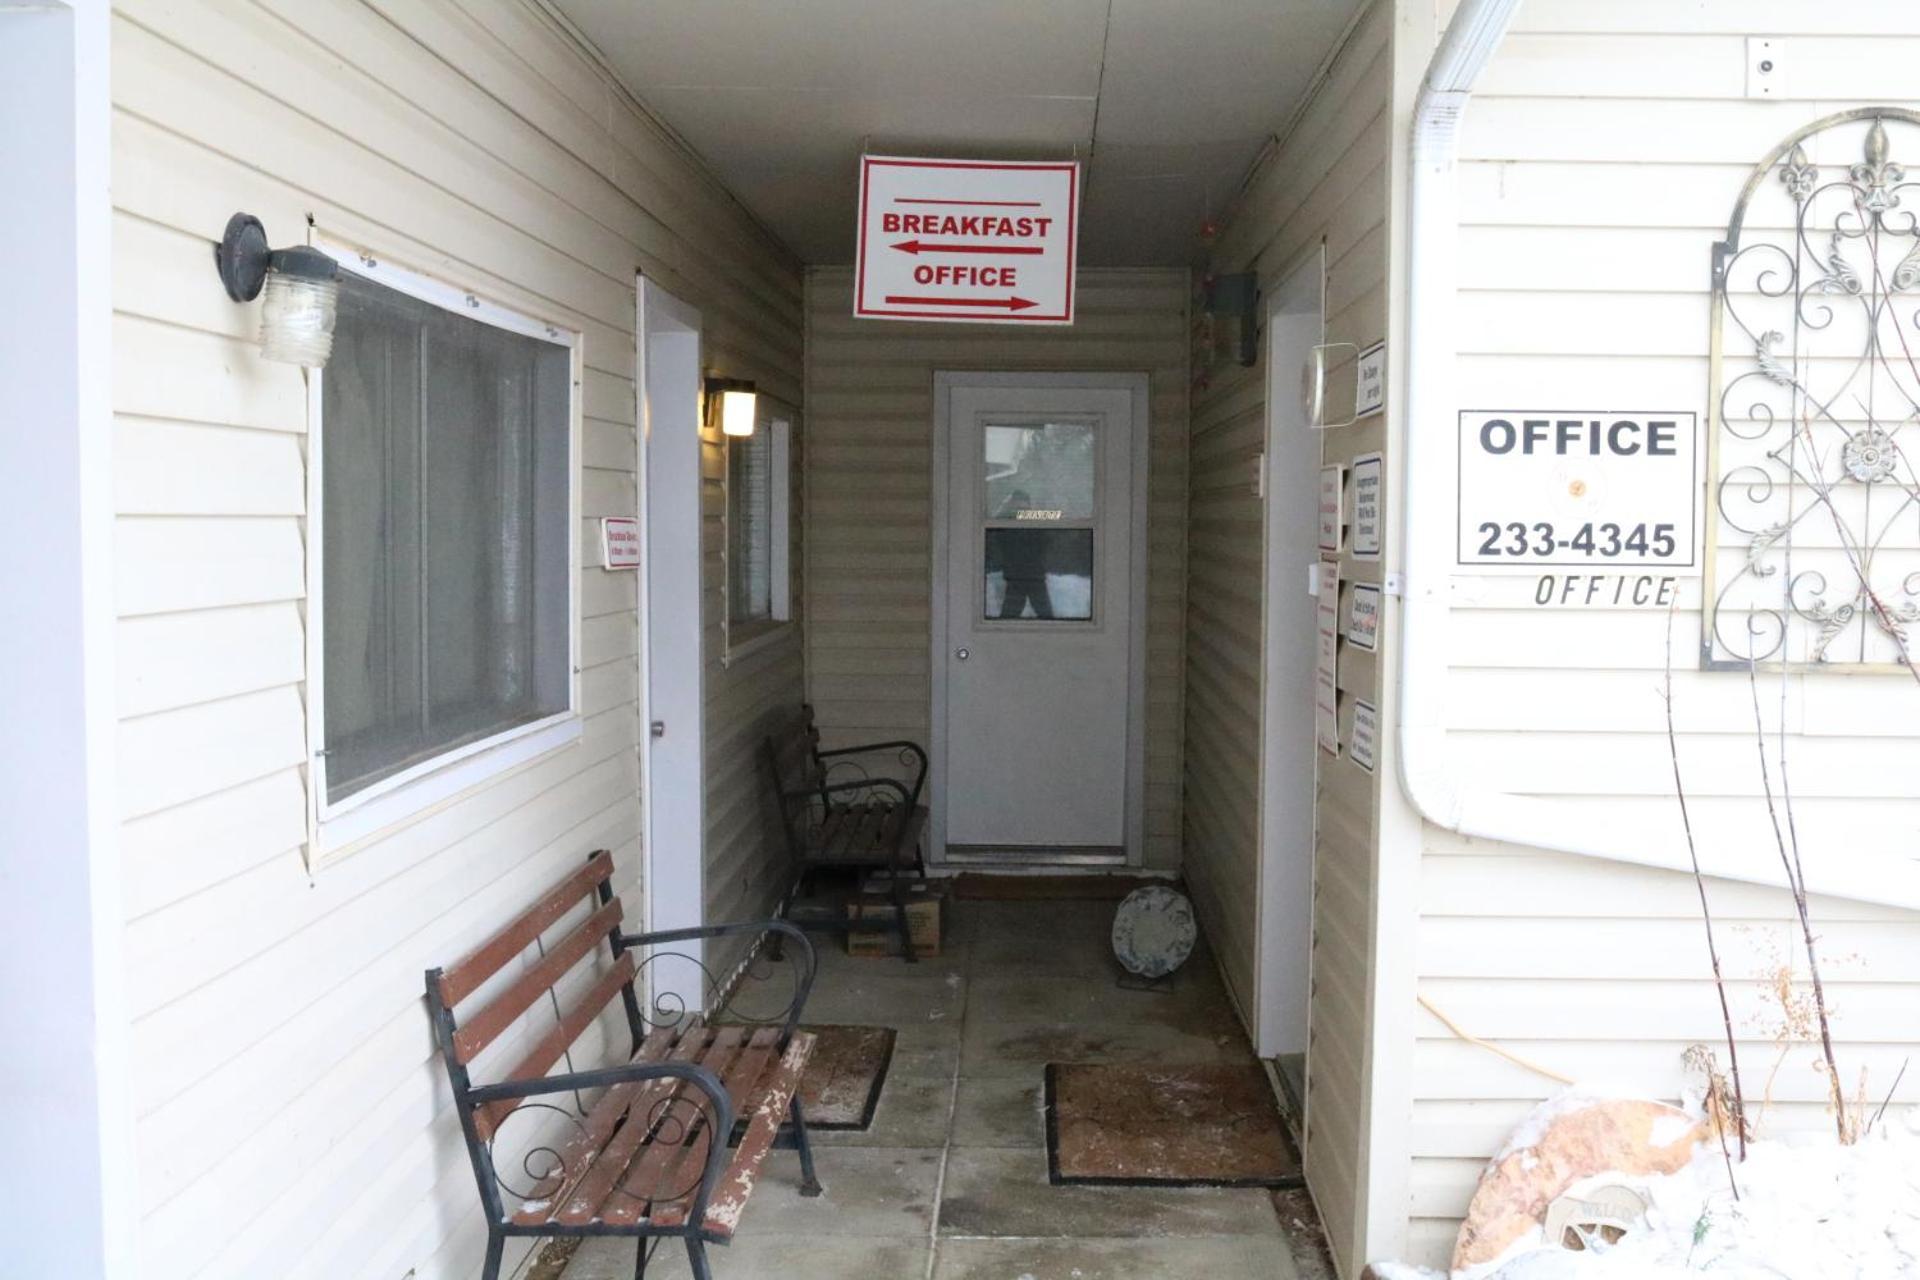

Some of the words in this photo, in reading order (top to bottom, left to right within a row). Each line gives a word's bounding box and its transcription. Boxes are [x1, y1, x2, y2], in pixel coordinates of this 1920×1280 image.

[882, 213, 1052, 237] BREAKFAST
[913, 265, 1016, 287] OFFICE
[1479, 419, 1677, 456] OFFICE
[1478, 522, 1676, 557] 233-4345
[1535, 575, 1675, 605] OFFICE
